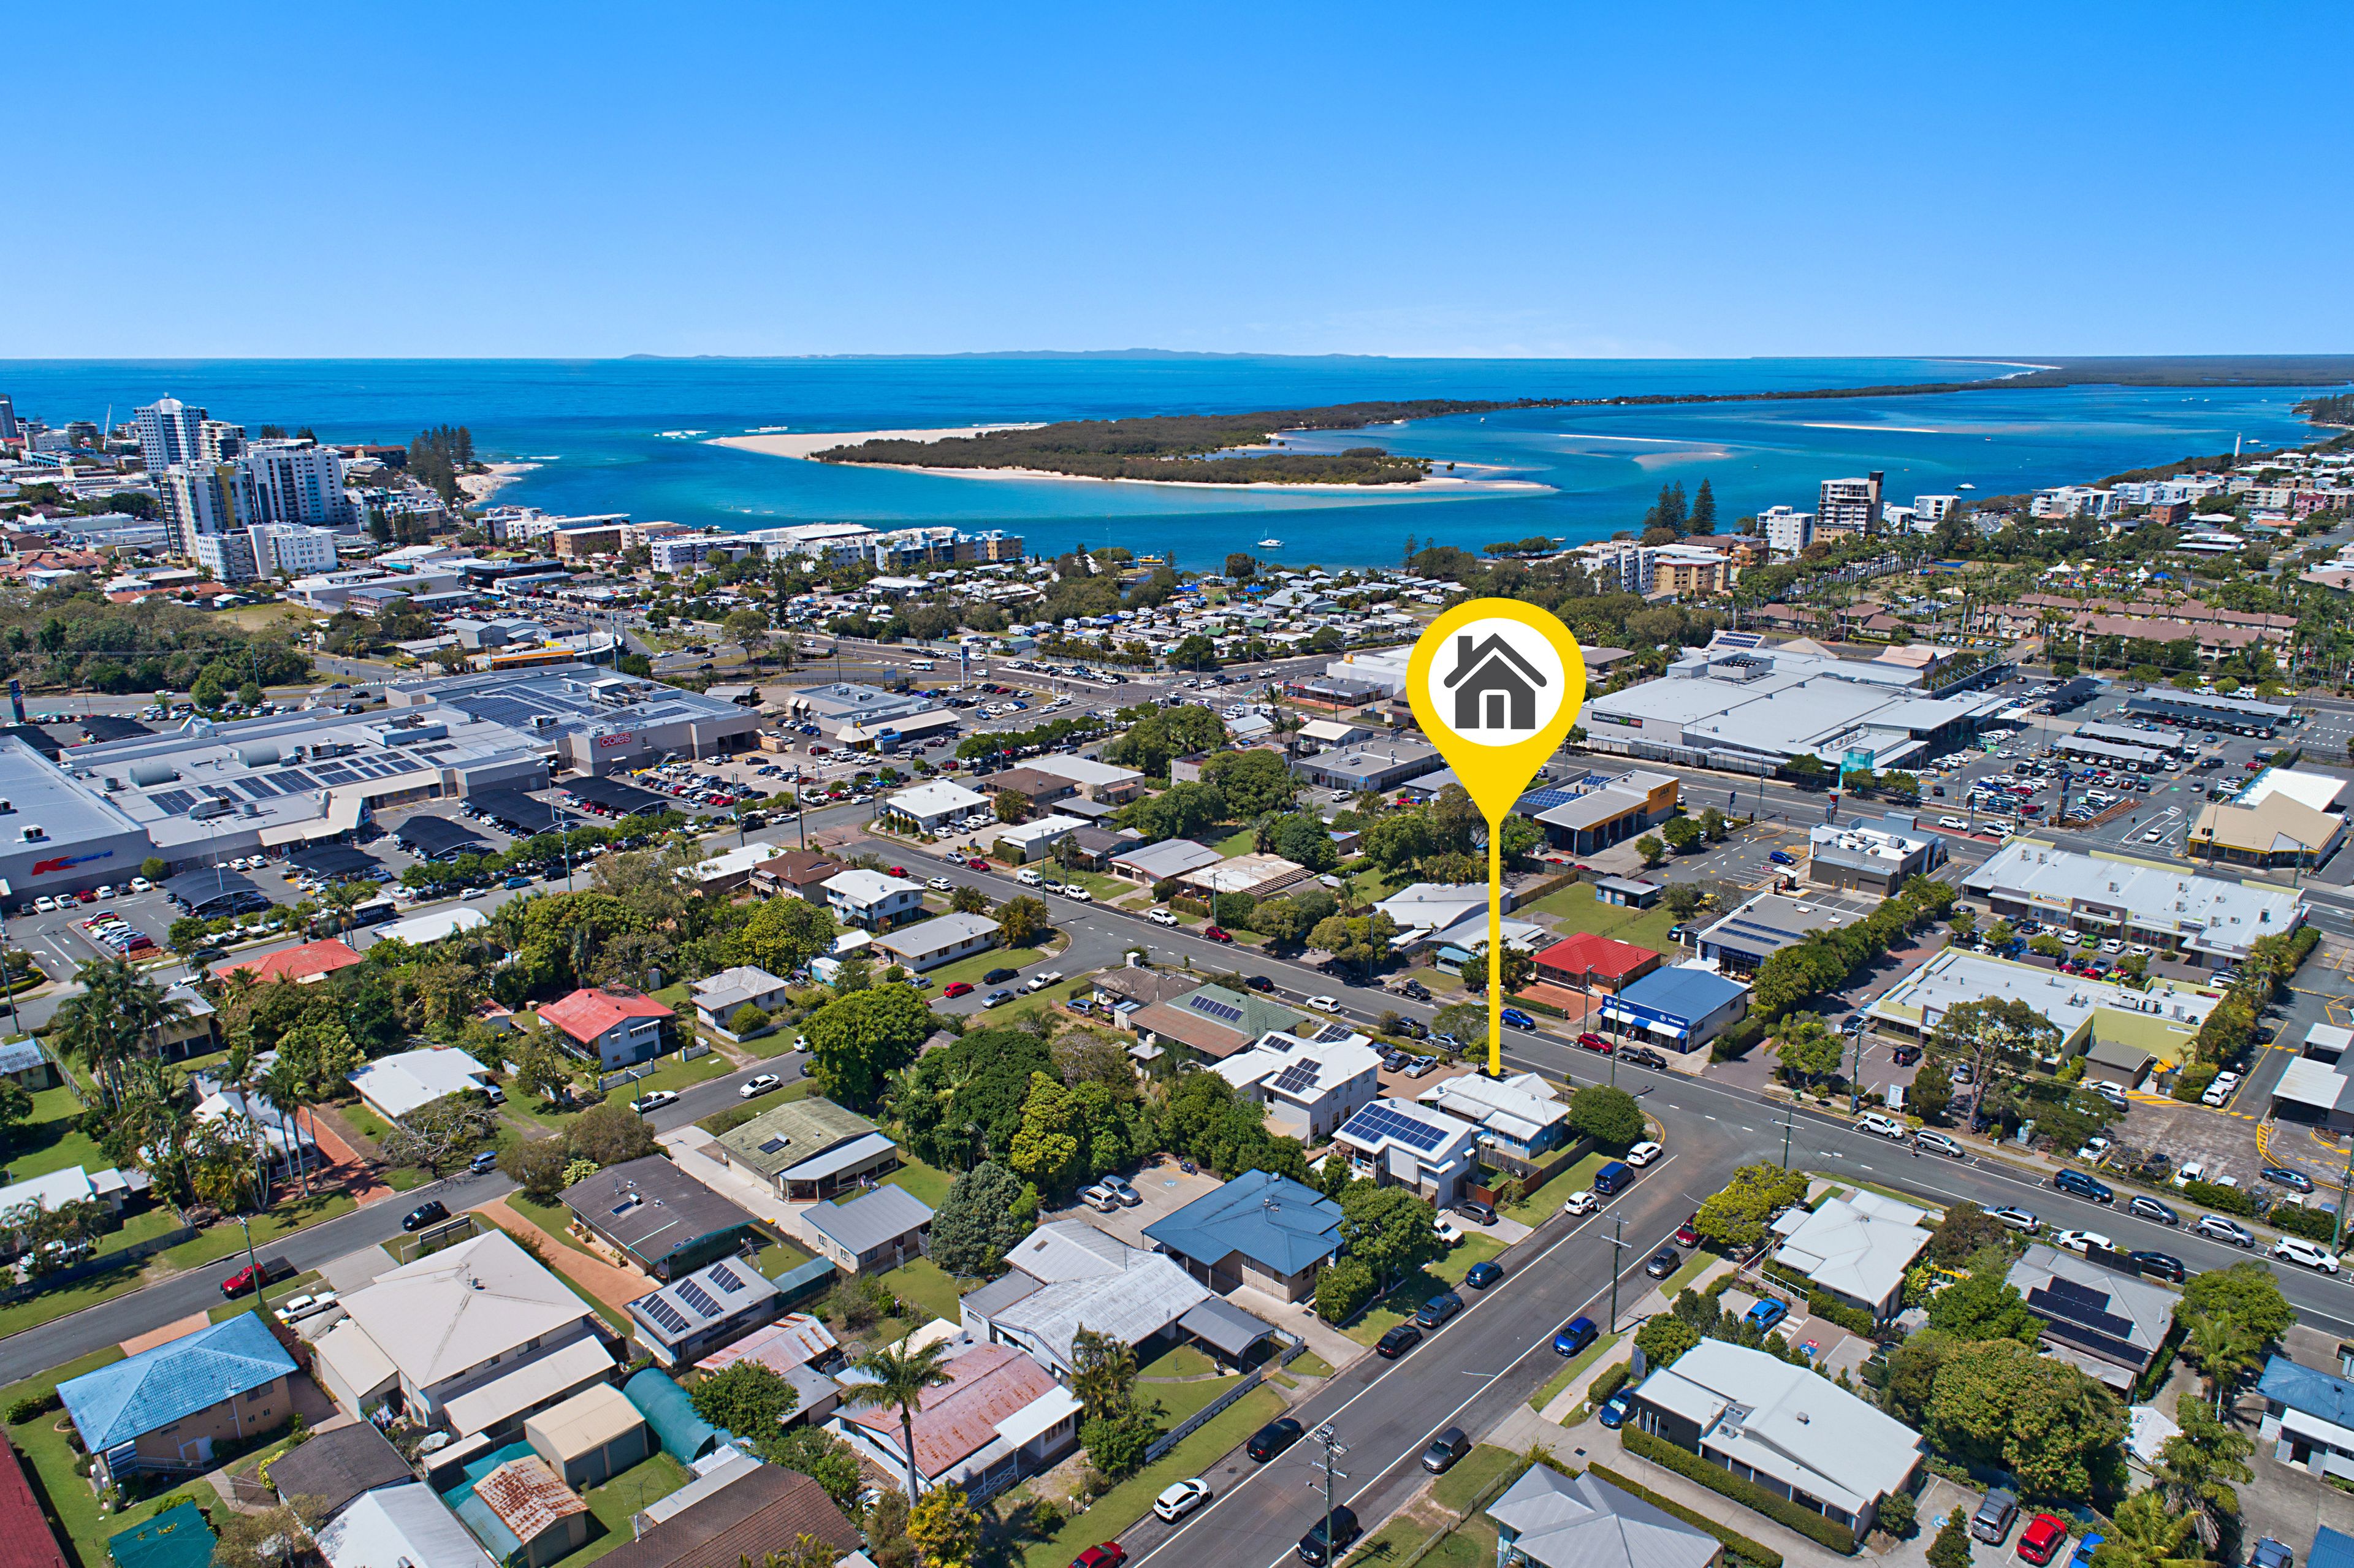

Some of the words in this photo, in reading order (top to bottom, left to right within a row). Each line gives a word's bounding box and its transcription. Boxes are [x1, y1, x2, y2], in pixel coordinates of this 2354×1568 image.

[1593, 713, 1620, 723] Woolworths
[601, 734, 631, 747] coles
[362, 907, 383, 918] estate
[1667, 1017, 1685, 1026] Vinnies
